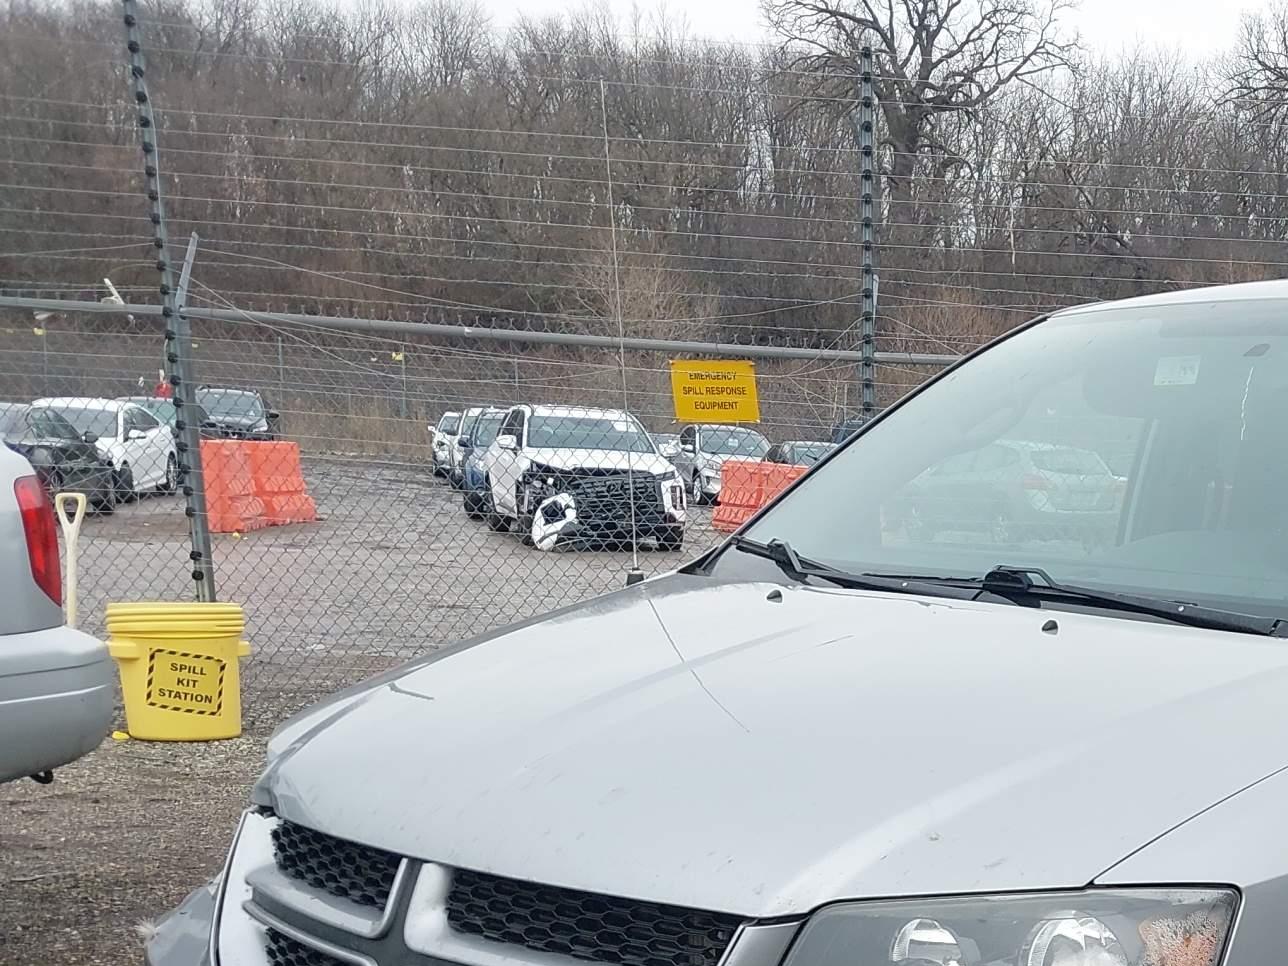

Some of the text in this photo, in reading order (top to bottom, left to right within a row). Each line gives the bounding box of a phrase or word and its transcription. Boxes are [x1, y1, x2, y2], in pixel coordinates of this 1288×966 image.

[689, 371, 737, 381] EMERGENCY
[682, 386, 747, 396] SPILL RESPONSE
[694, 401, 738, 410] EQUIPMENT
[170, 662, 207, 676] SPILL
[176, 677, 199, 688] KIT
[158, 687, 213, 704] STATION
